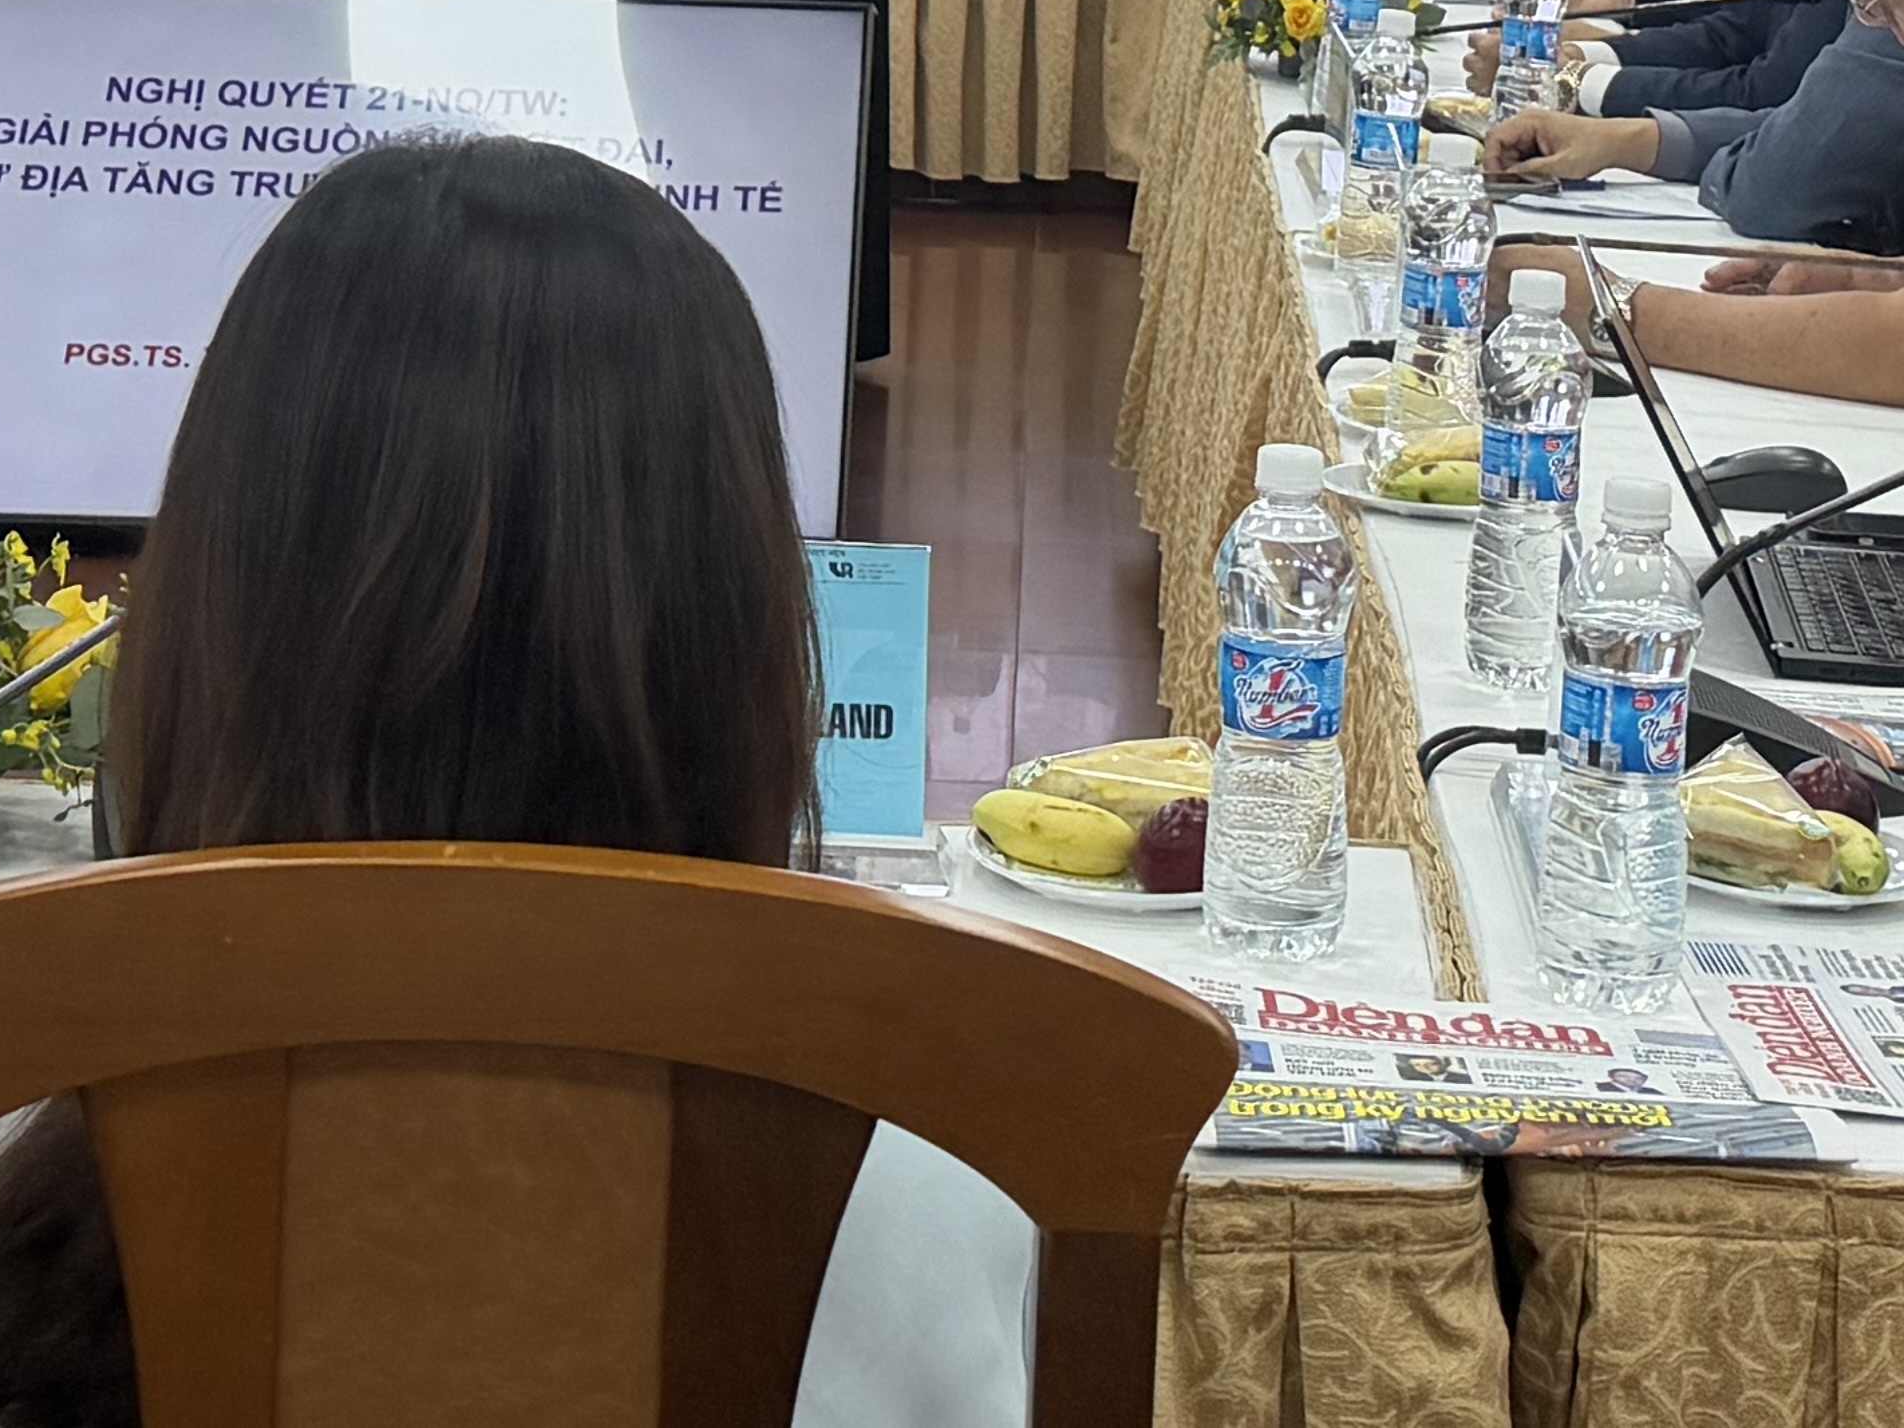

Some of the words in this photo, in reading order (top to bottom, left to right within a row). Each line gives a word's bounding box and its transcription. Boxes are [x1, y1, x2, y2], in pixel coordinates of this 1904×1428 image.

[105, 76, 205, 111] NGHỊ
[217, 76, 357, 111] QUYẾT
[366, 86, 568, 119] 21-NQ/TW:
[81, 116, 228, 152] PHÓNG
[20, 164, 89, 198] ĐỊA
[103, 161, 215, 197] TĂNG
[230, 170, 323, 199] TRƯ
[665, 184, 719, 212] NH
[733, 180, 783, 214] TẾ
[64, 343, 190, 369] PGS.TS.
[828, 702, 894, 740] AND
